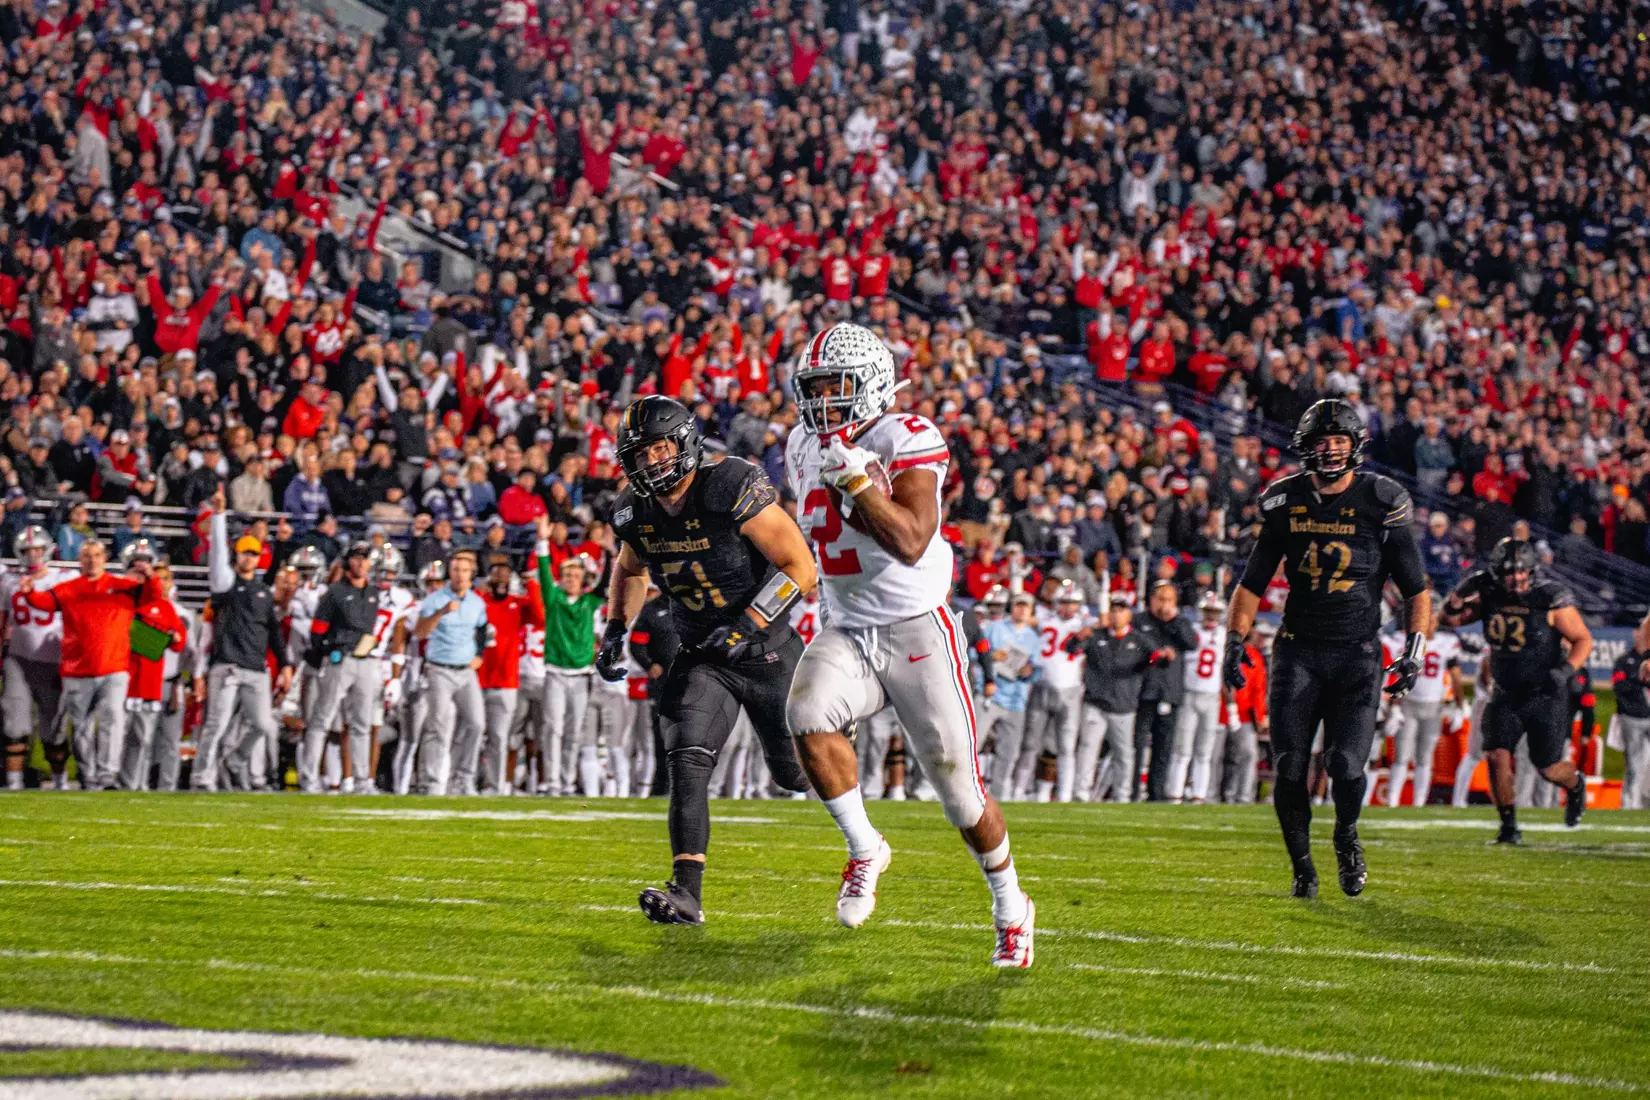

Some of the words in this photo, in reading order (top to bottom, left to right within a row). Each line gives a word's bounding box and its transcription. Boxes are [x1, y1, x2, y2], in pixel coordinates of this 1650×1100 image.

[897, 414, 930, 433] 2
[803, 488, 862, 575] 2
[1289, 516, 1357, 535] Northwestern
[1298, 540, 1356, 594] 42
[661, 561, 728, 611] 51
[796, 612, 815, 645] 4
[1488, 613, 1527, 652] 93
[1197, 648, 1216, 678] 8
